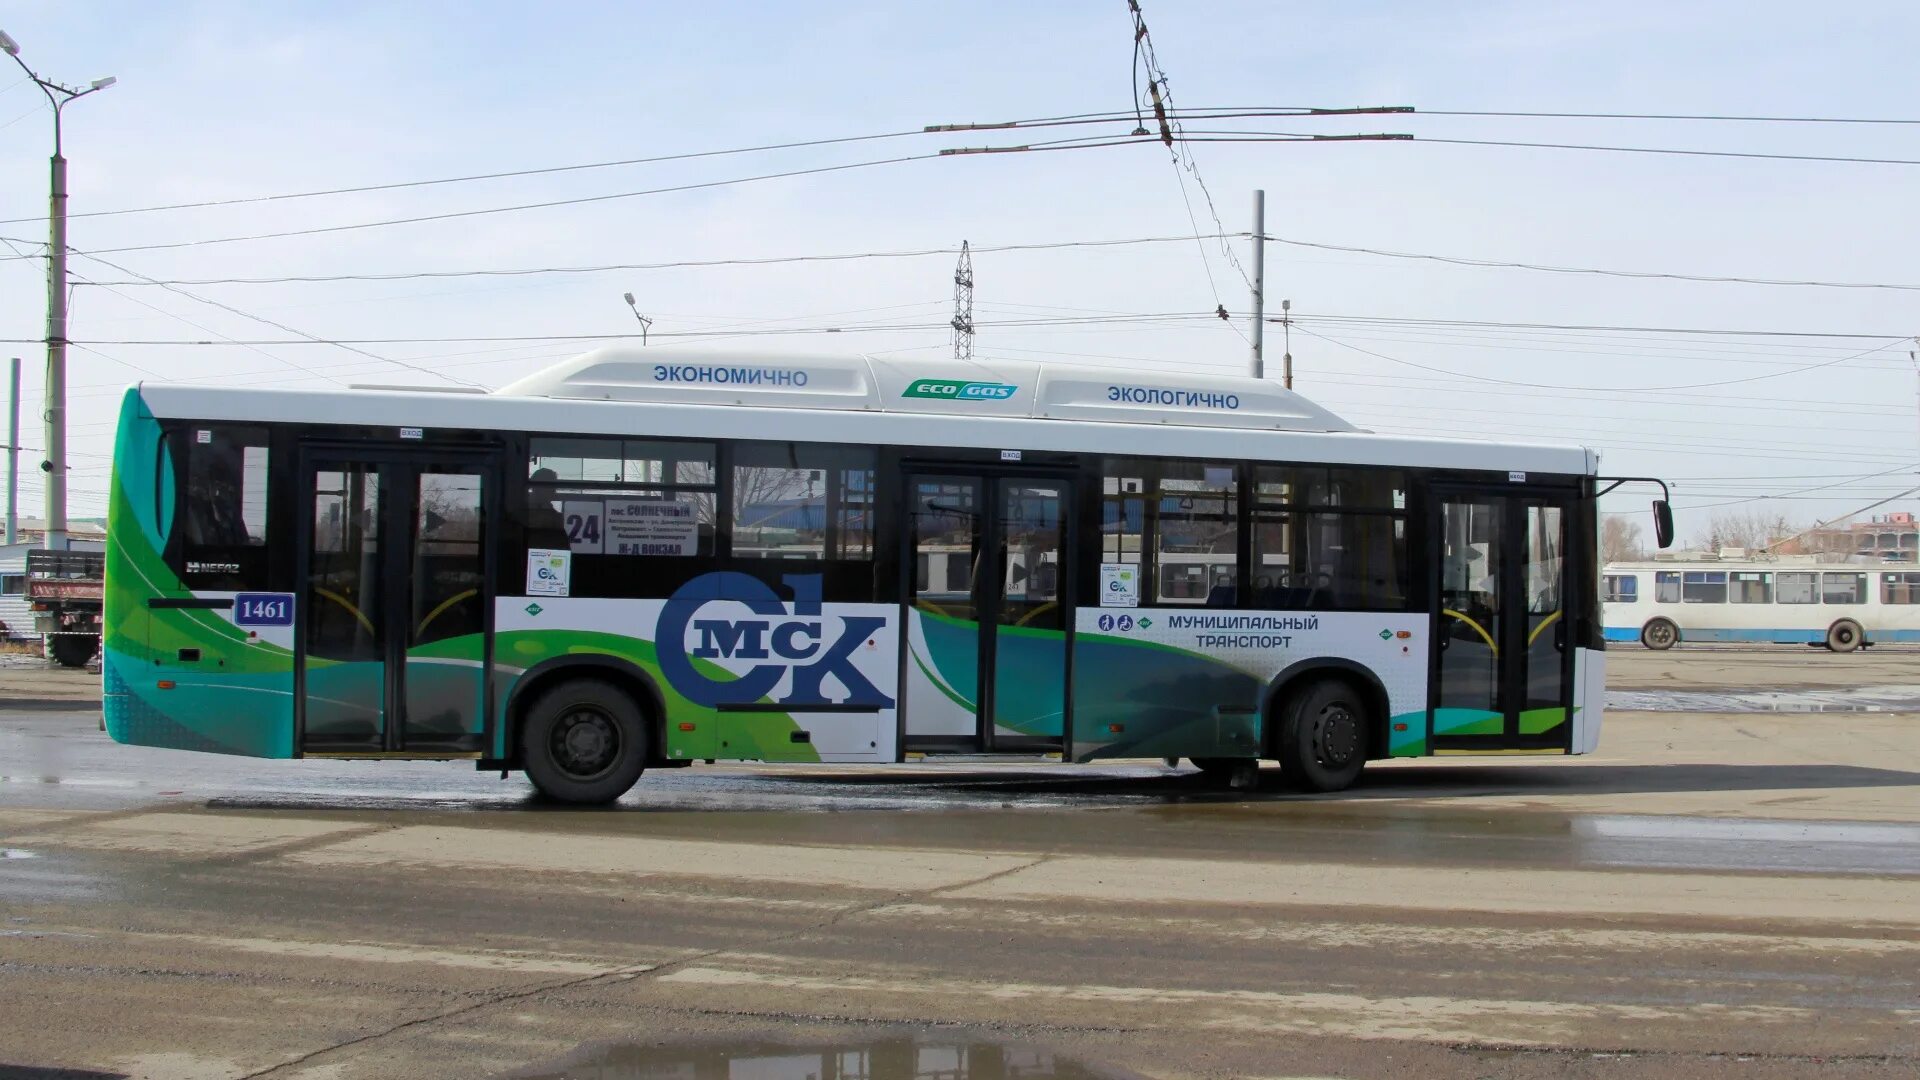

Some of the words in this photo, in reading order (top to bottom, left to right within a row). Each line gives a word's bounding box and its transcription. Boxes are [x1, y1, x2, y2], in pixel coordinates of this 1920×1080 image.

[653, 364, 809, 388] ЭКОНОМИЧНО
[916, 383, 957, 394] ECO
[1107, 386, 1240, 410] ЭКОЛОГИЧНО
[401, 429, 422, 437] ВХОД
[1002, 451, 1021, 459] ВХОД
[626, 504, 691, 517] СОЛНЕЧНЫЙ
[566, 514, 600, 544] 24
[641, 543, 682, 555] ВОКЗАЛ
[201, 563, 240, 573] NEFAZ
[243, 600, 286, 618] 1461
[1168, 614, 1319, 631] МУНИЦИПАЛЬНЫЙ
[1196, 635, 1293, 648] ТРАНСПОРТ
